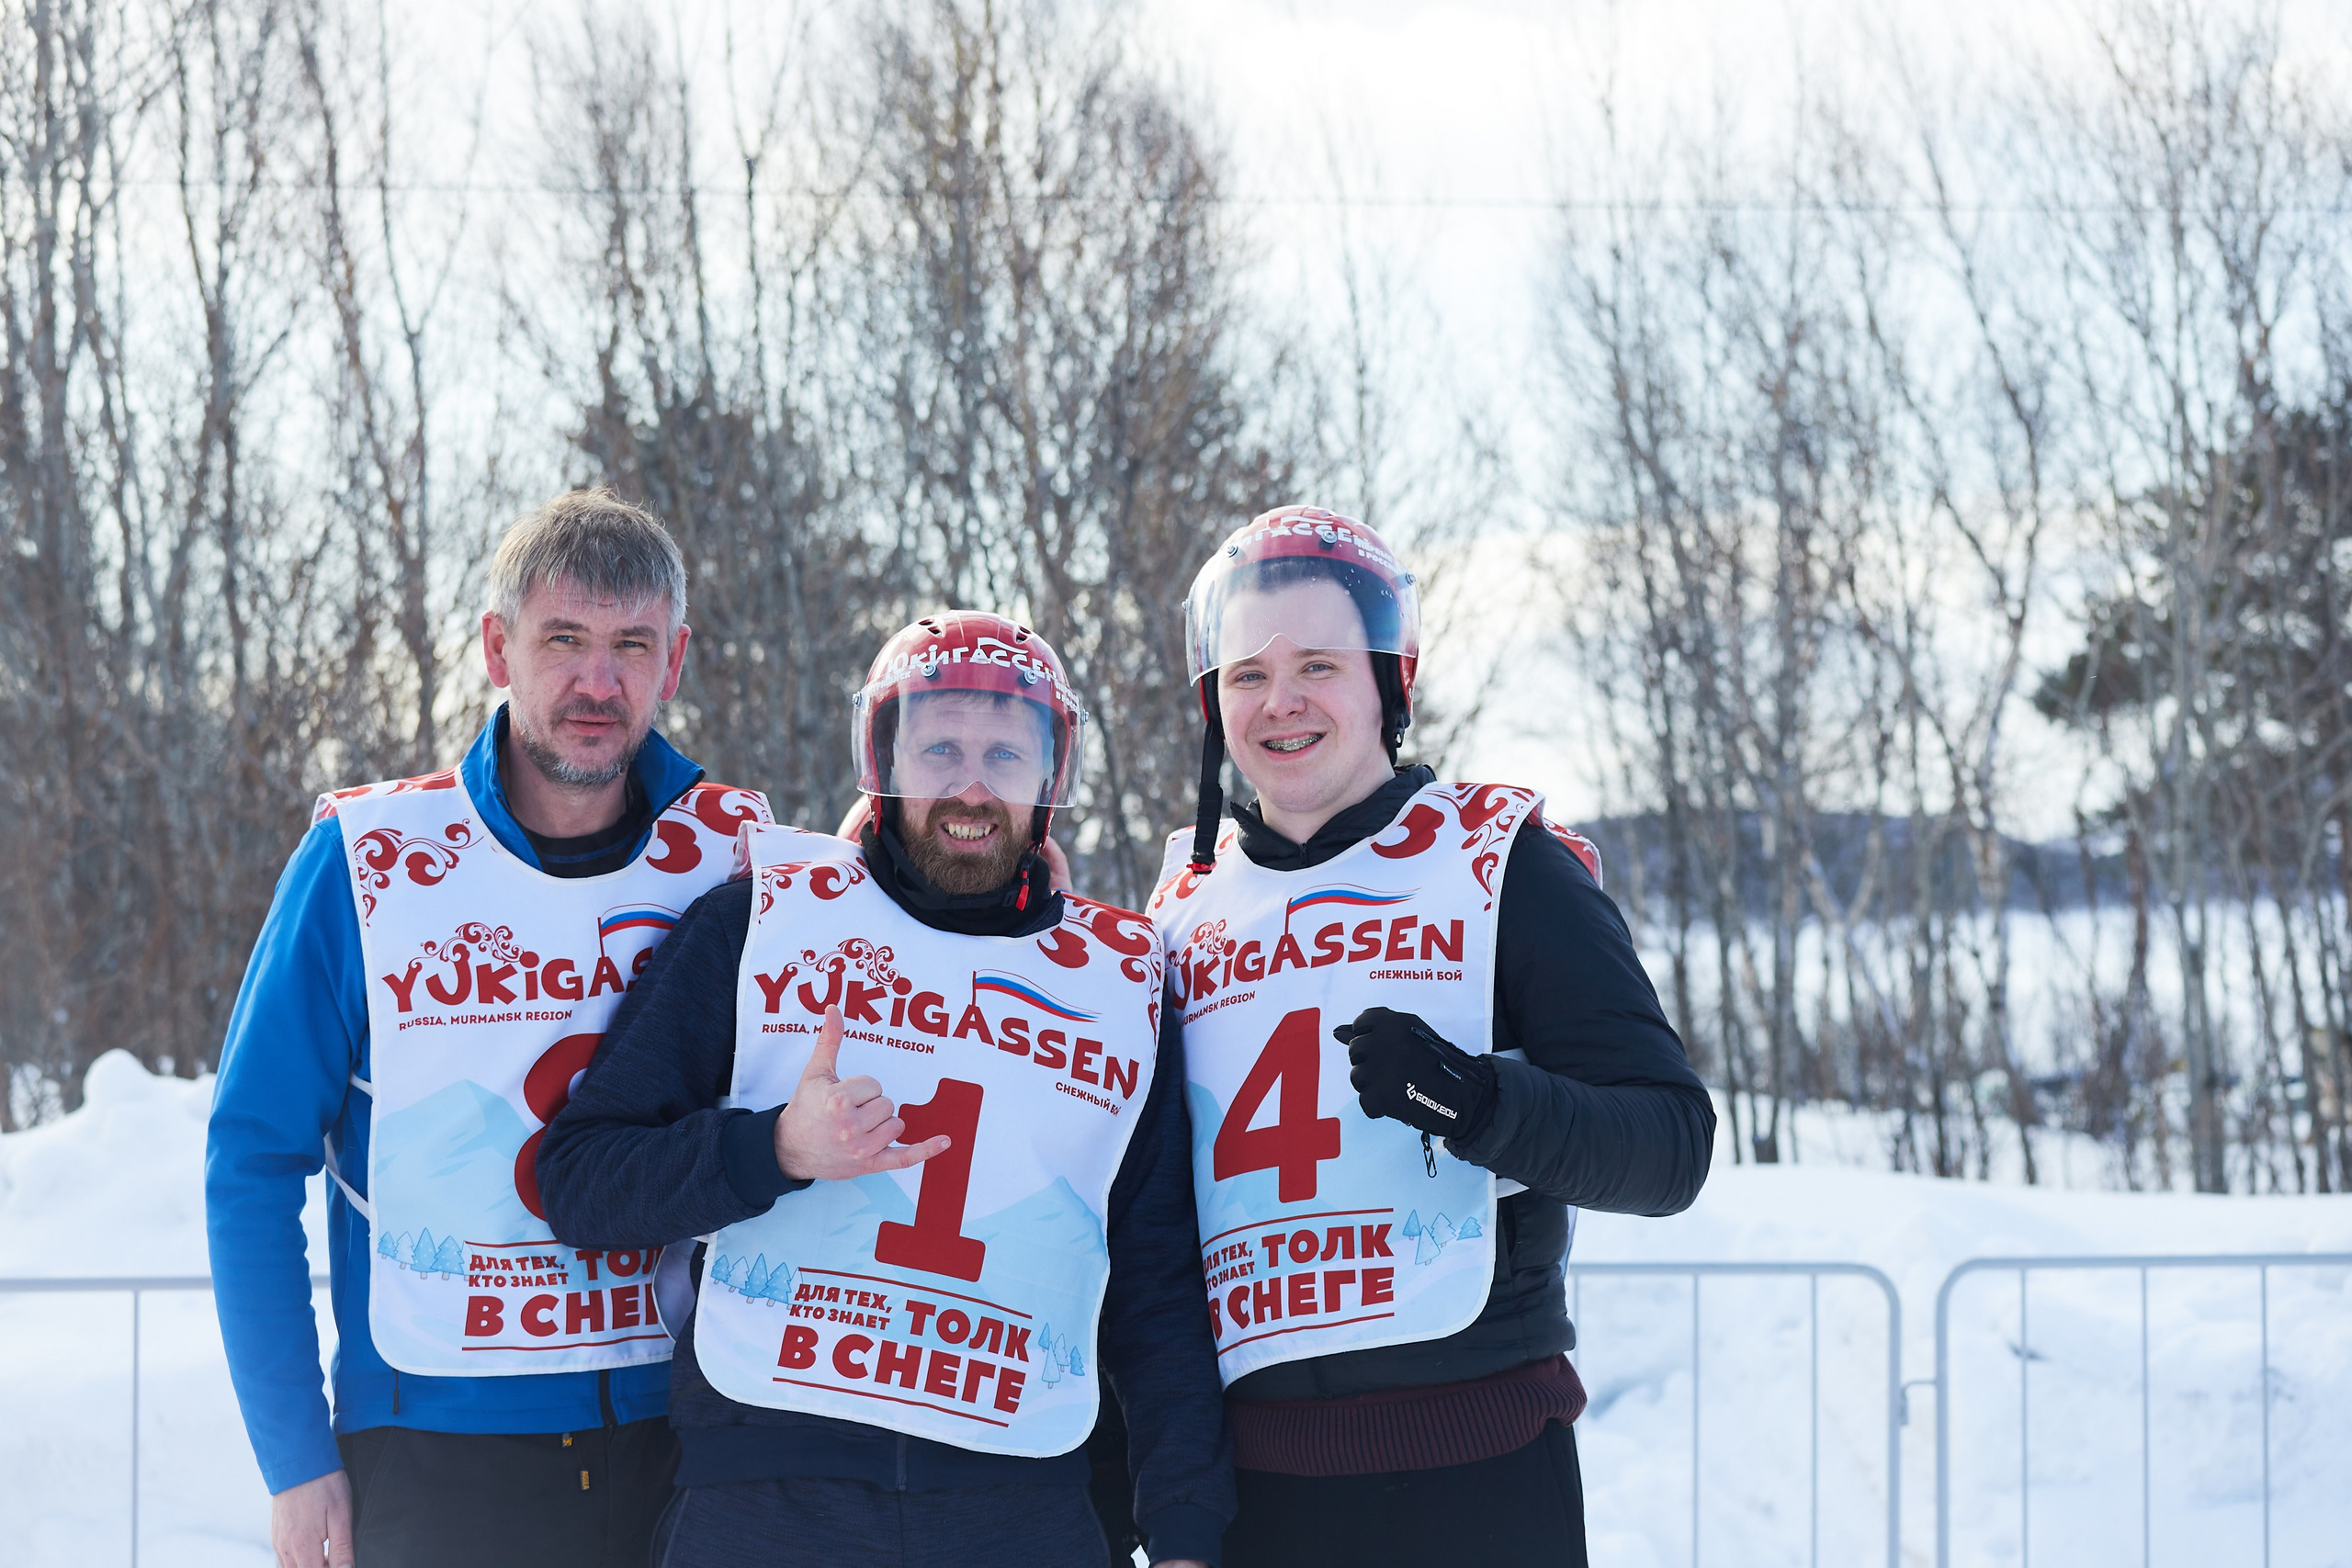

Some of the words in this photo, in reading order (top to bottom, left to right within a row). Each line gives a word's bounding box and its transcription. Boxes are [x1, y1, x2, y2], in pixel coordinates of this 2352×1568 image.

[1369, 968, 1433, 980] СНЕЖНЫЙ
[1437, 969, 1463, 981] БОЙ
[1219, 990, 1256, 1010] REGION
[399, 1015, 447, 1031] RUSSIA,
[450, 1011, 522, 1025] MURMANSK
[526, 1010, 573, 1021] REGION
[762, 1023, 809, 1034] RUSSIA,
[813, 1024, 883, 1044] MMANSK
[887, 1037, 935, 1054] REGION
[1056, 1081, 1111, 1111] СНЕЖНЫЙ
[1214, 1007, 1340, 1204] 4
[874, 1077, 987, 1282] 1
[1221, 1241, 1252, 1263] ТЕХ,
[1261, 1224, 1395, 1269] ТОЛК
[469, 1254, 514, 1271] ДЛЯ
[515, 1255, 566, 1271] ТЕХ,
[1206, 1275, 1218, 1292] ТО
[1218, 1261, 1255, 1285] ЗНАЕТ
[469, 1275, 507, 1288] КТО
[510, 1272, 569, 1288] ЗНАЕТ
[794, 1283, 841, 1303] ДЛЯ
[844, 1288, 892, 1314] ТЕХ,
[1227, 1267, 1395, 1330] СНЕГЕ
[464, 1295, 504, 1337] В
[789, 1303, 825, 1320] КТО
[827, 1308, 890, 1331] ЗНАЕТ
[905, 1299, 1032, 1362] ТОЛК
[777, 1324, 819, 1371] В
[831, 1333, 1026, 1414] СНЕГЕ
